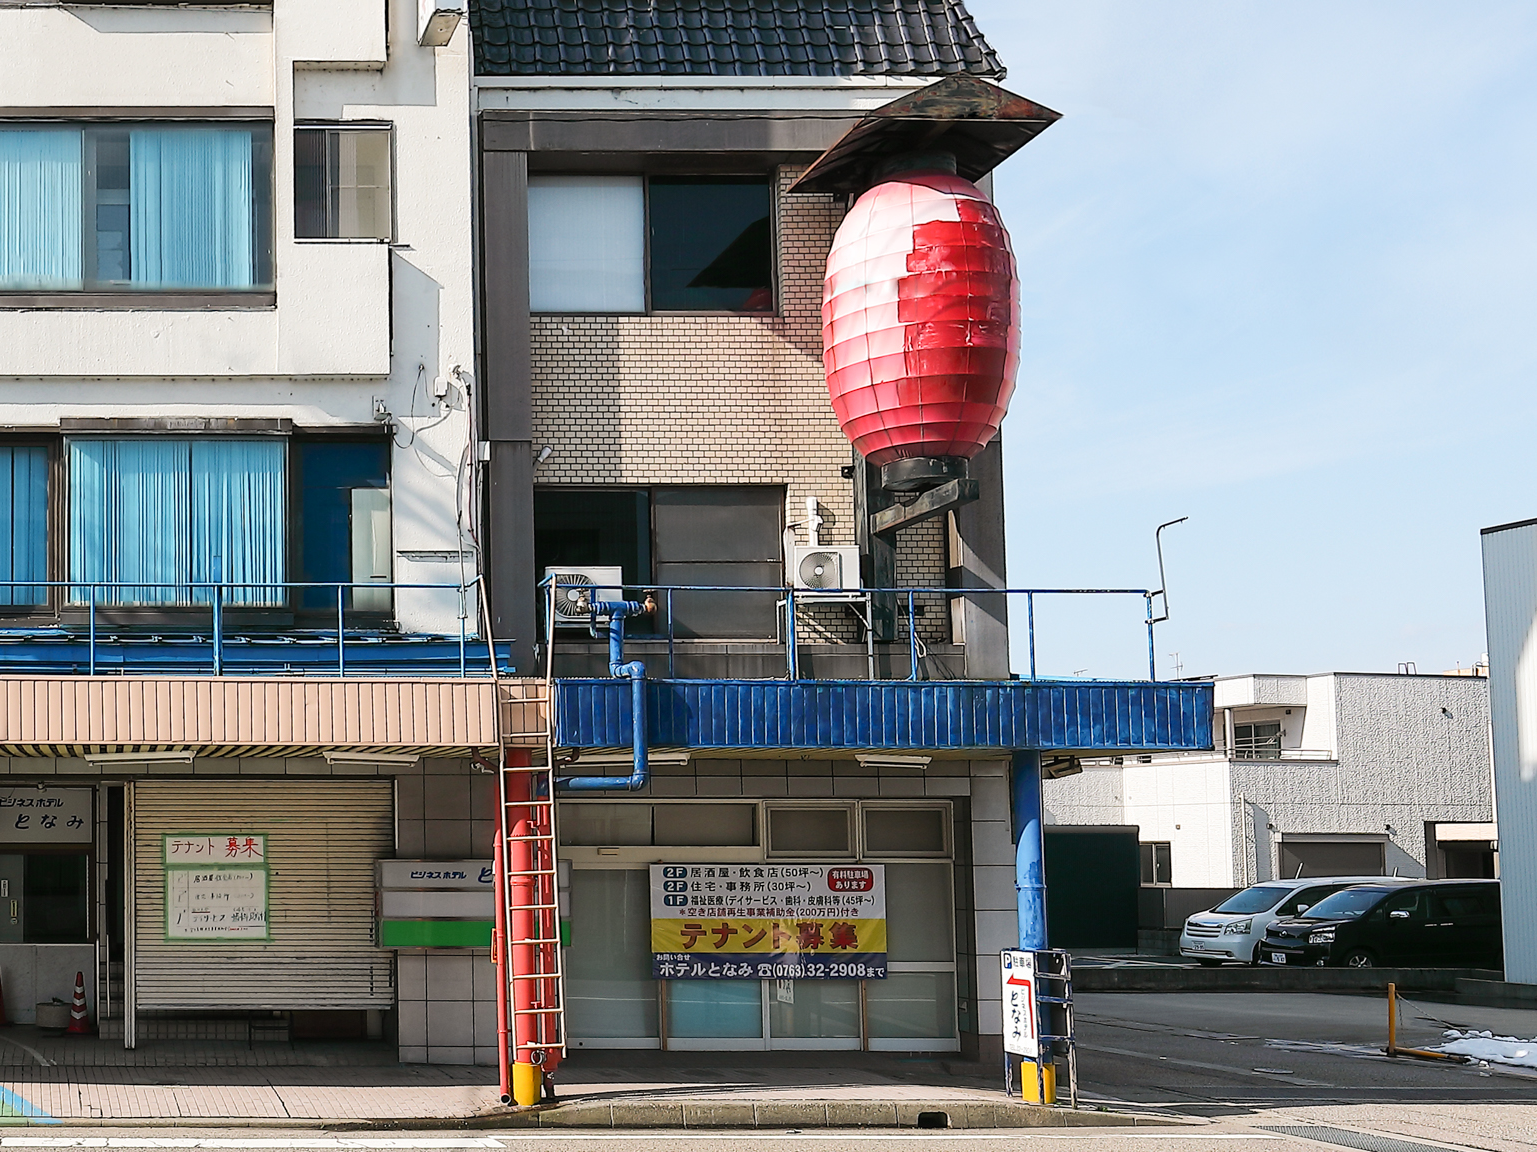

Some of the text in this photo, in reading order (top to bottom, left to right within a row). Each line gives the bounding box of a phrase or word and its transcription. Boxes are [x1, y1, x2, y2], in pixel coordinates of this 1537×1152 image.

[0, 797, 64, 808] ビジネスホテル
[15, 814, 84, 829] となみ
[171, 837, 215, 856] テナント
[410, 870, 467, 880] ビジネスホテル
[666, 868, 684, 878] 2F
[667, 882, 684, 891] 2F
[835, 881, 867, 890] あります
[668, 896, 685, 905] 1F
[680, 921, 860, 949] テナント募集
[659, 963, 753, 977] ホテルとなみ
[1011, 990, 1021, 1041] となみ
